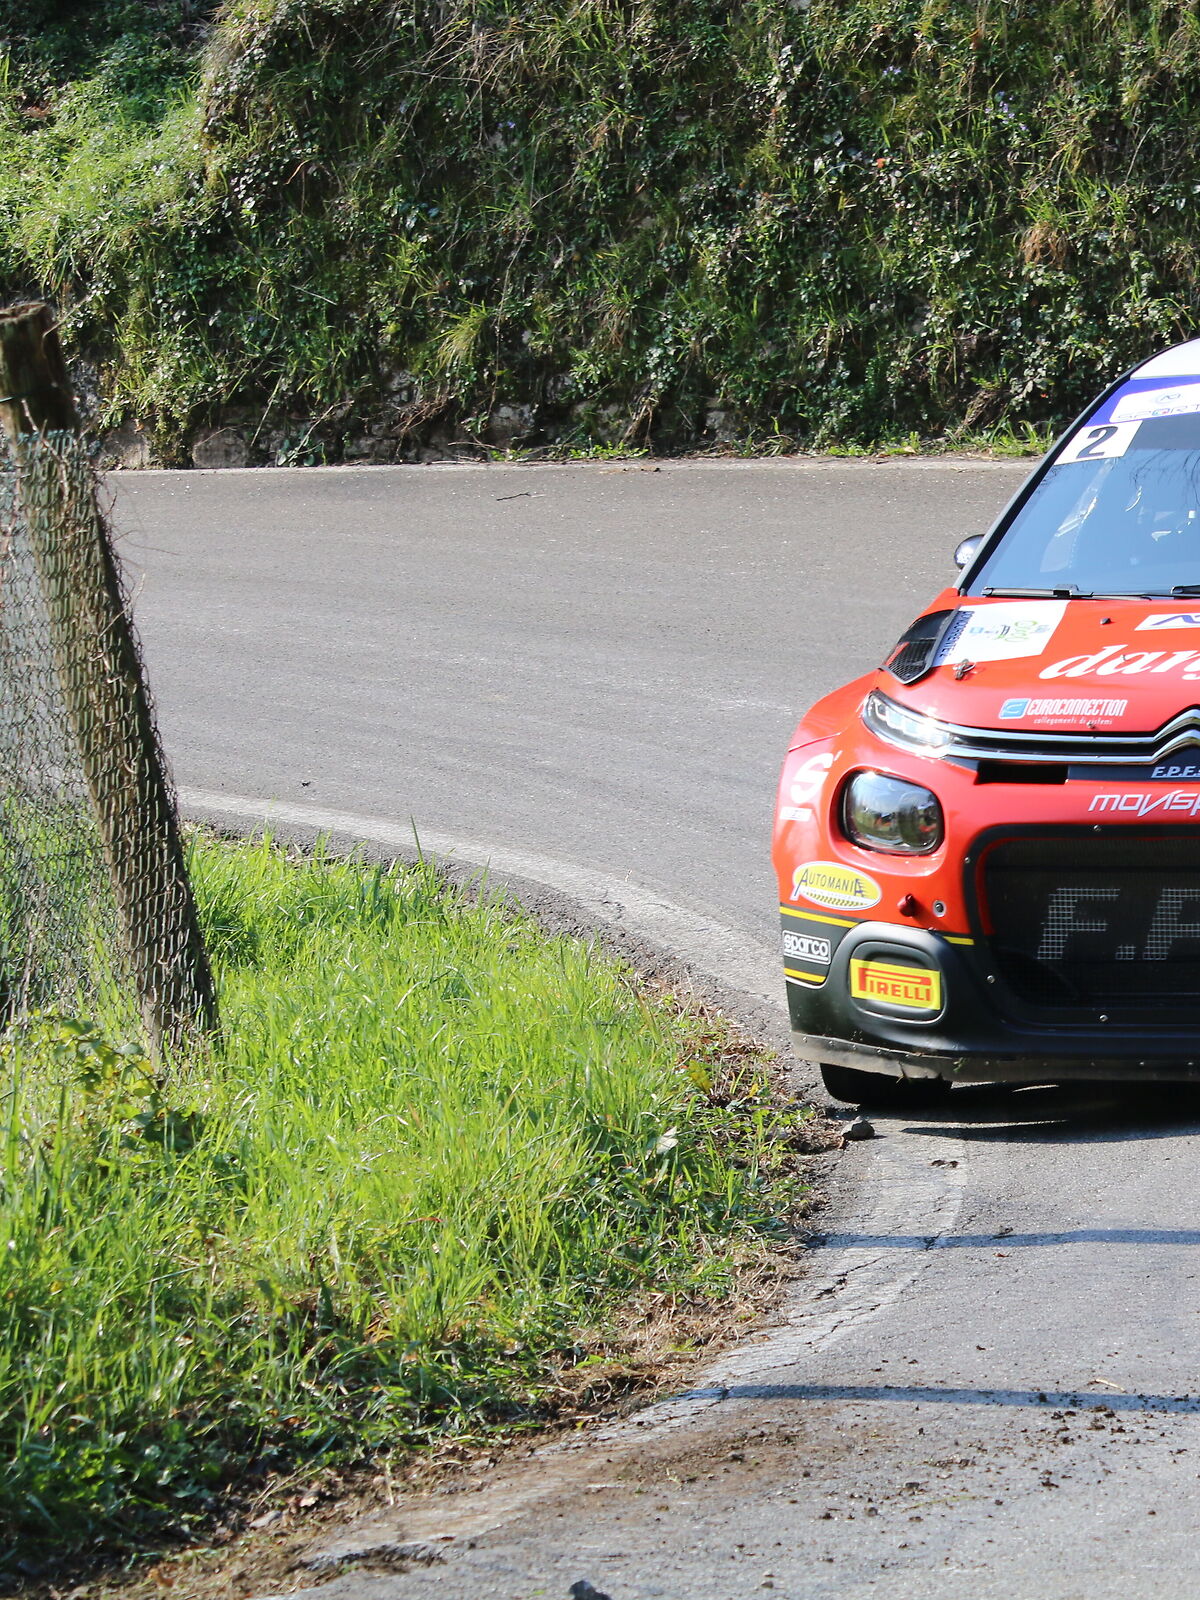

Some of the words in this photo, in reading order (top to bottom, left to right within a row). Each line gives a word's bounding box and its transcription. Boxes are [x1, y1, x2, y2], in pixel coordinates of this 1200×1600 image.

[1075, 425, 1119, 459] 2
[1027, 699, 1129, 717] EUROCONNECTION
[794, 868, 866, 898] AUTOMANIA
[784, 933, 829, 957] sparco
[858, 967, 932, 1002] PIRELLI
